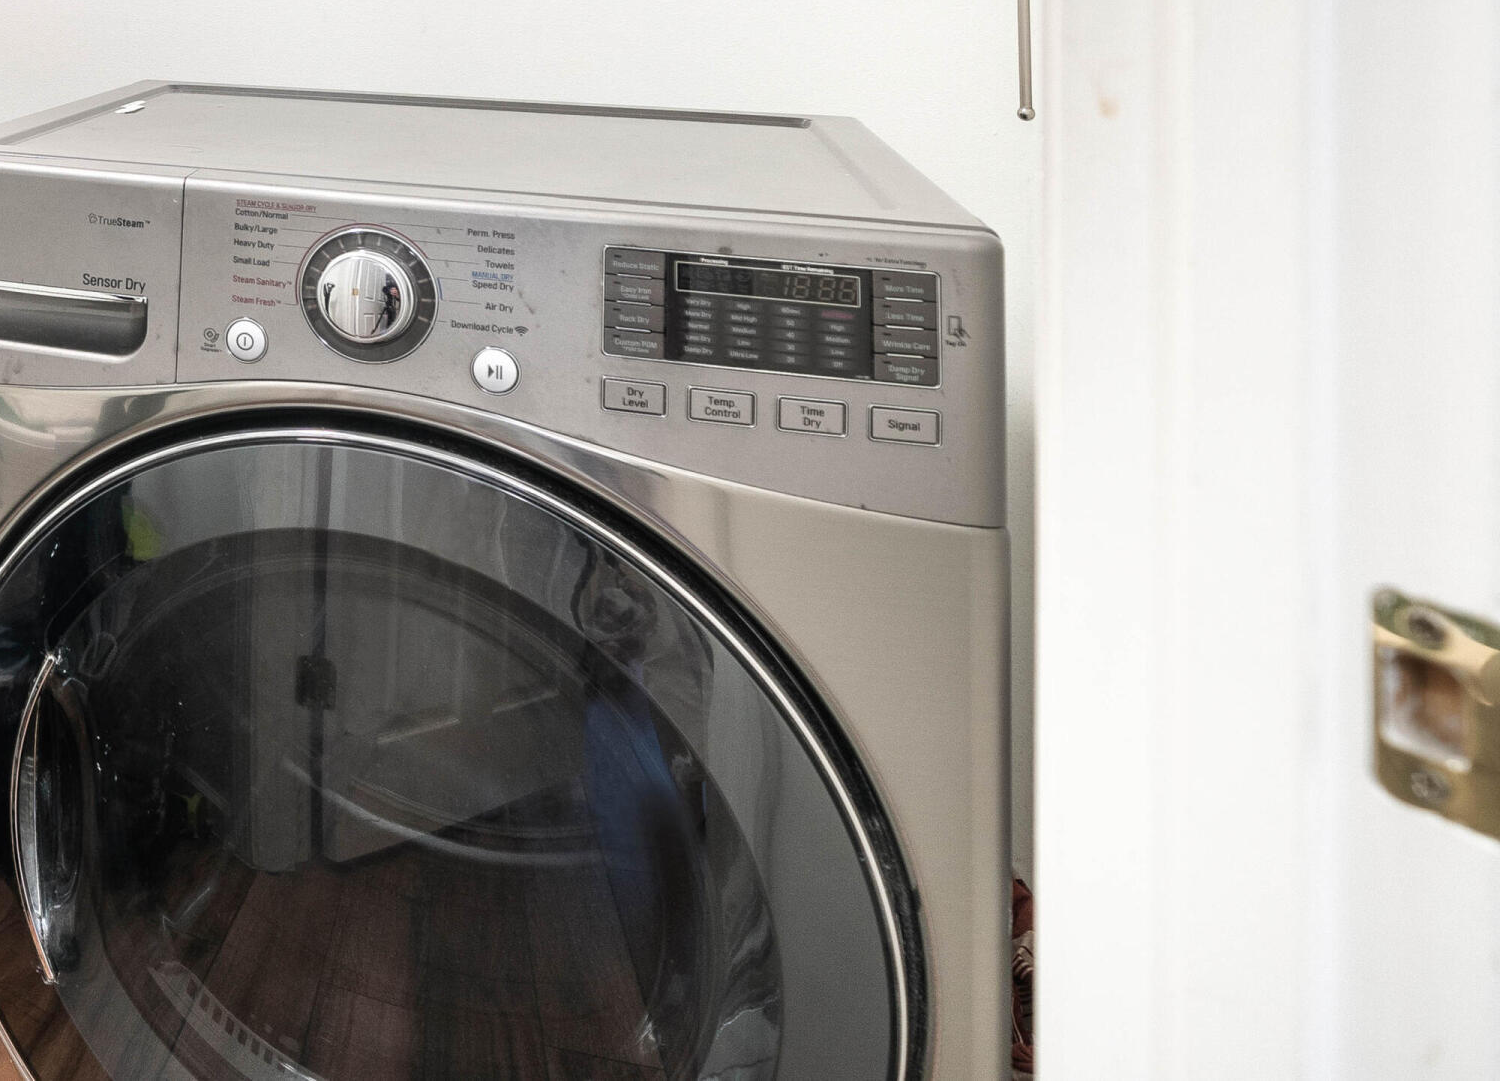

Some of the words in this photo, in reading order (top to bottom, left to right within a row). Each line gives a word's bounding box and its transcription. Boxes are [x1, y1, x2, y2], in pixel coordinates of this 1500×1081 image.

[236, 199, 256, 207] STEAM
[235, 208, 289, 219] Cotton/Normal
[234, 223, 278, 234] Bulky/Large
[468, 229, 489, 237] Perm.
[493, 230, 515, 239] Press
[234, 239, 256, 248] Heavy
[257, 240, 275, 250] Duty
[478, 245, 515, 255] Delicates
[233, 256, 251, 264] Small
[485, 260, 515, 270] Towels
[613, 260, 638, 269] Reduce
[83, 273, 123, 288] Sensor
[125, 277, 146, 293] Dry
[233, 275, 255, 284] Steam
[472, 280, 498, 289] Speed
[500, 283, 514, 292] Dry
[621, 286, 637, 294] Easy
[906, 286, 924, 294] Time
[232, 295, 255, 304] Steam
[500, 304, 514, 313] Dry
[637, 316, 649, 325] Dry
[906, 314, 924, 322] Time
[451, 320, 490, 331] Download
[492, 325, 513, 334] Cycle
[883, 340, 911, 349] Wrinkle
[913, 342, 931, 351] Care
[702, 347, 713, 355] Dry
[888, 365, 910, 374] Damp
[912, 367, 925, 375] Dry
[896, 372, 919, 382] Signal
[627, 387, 644, 398] Dry
[622, 397, 649, 408] Level
[705, 408, 740, 418] Control
[800, 406, 825, 417] Time
[803, 417, 821, 428] Dry
[888, 419, 921, 432] Signal
